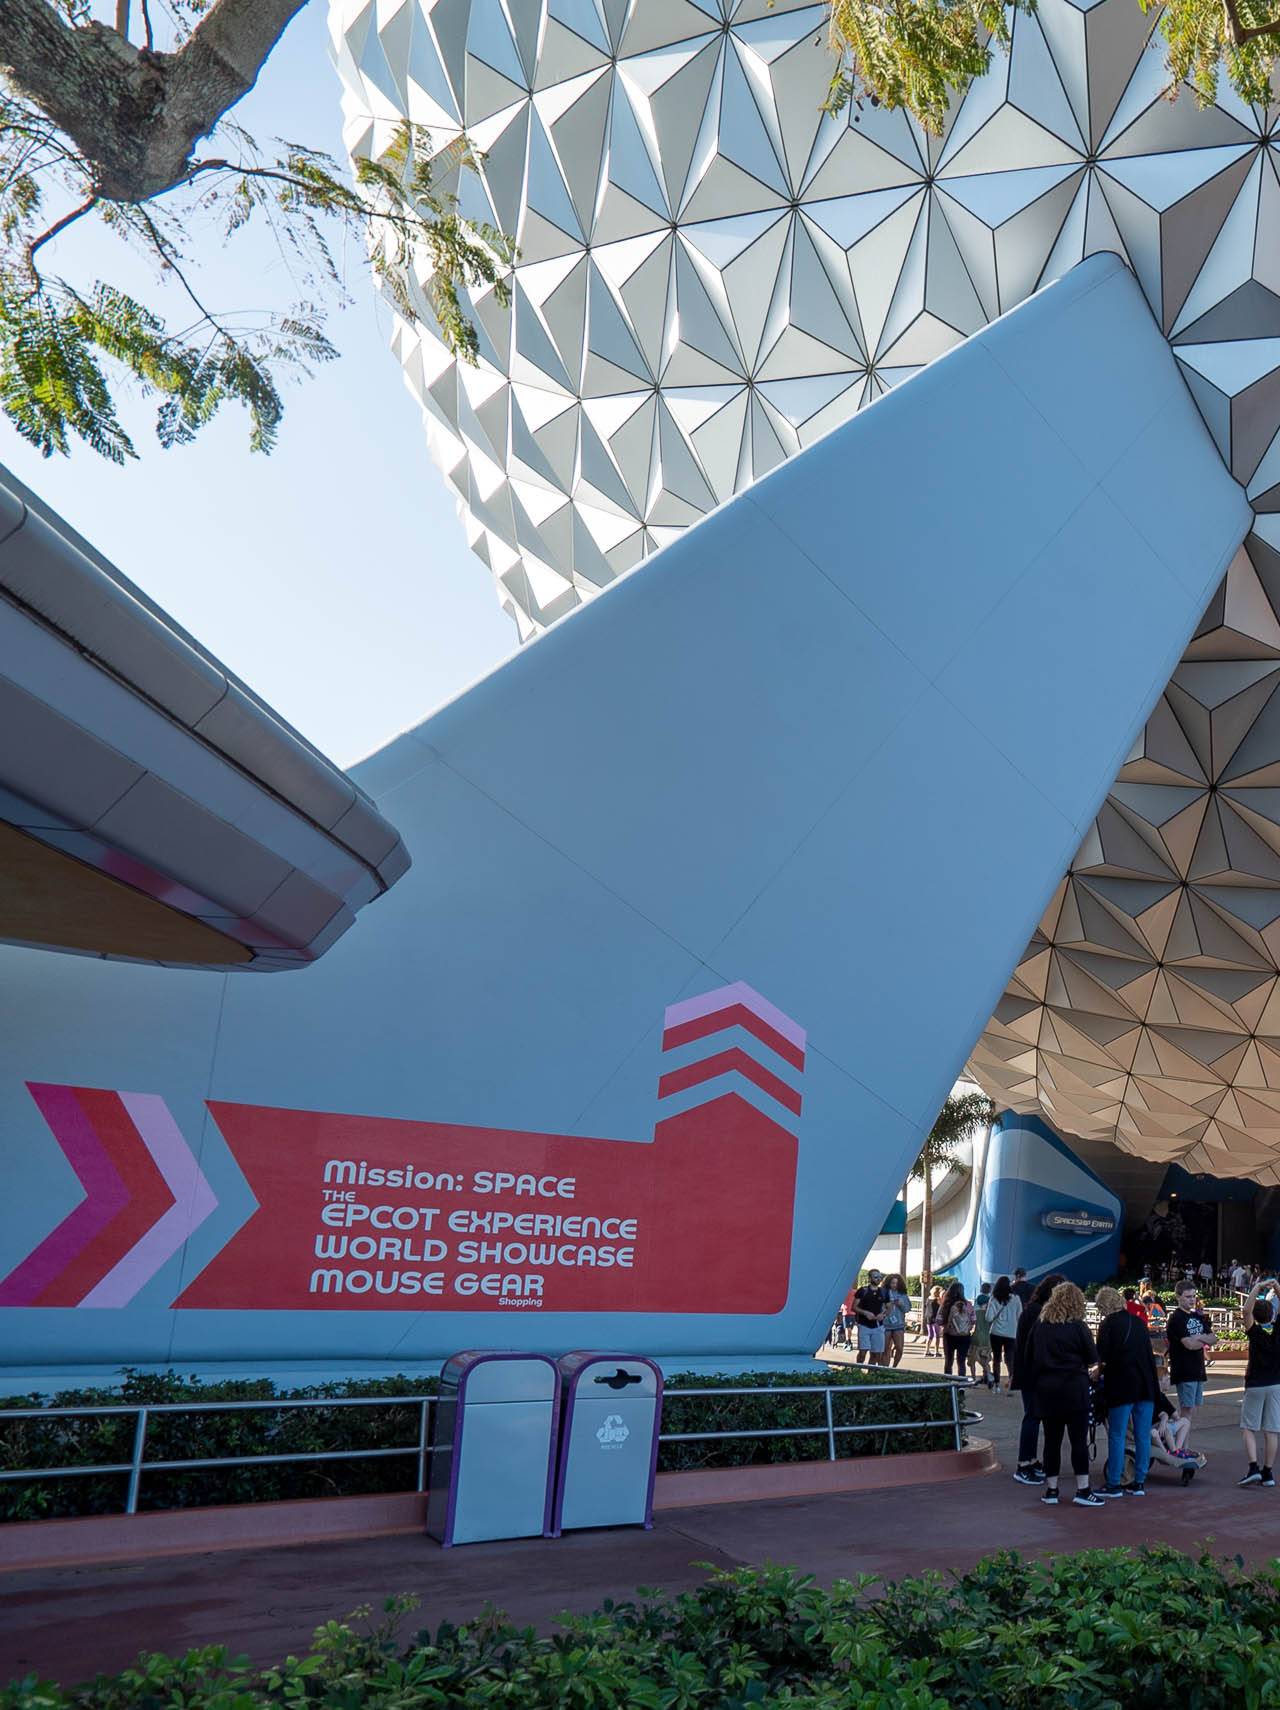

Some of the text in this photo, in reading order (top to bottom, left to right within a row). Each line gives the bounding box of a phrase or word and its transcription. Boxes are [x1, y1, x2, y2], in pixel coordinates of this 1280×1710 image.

[323, 1159, 576, 1199] Mission: SPACE
[322, 1189, 356, 1202] THE
[321, 1203, 638, 1240] EPCOT EXPERIENCE
[314, 1234, 634, 1267] WORLD SHOWCASE
[309, 1268, 544, 1297] MOUSE GEAR
[498, 1297, 543, 1307] Shopping
